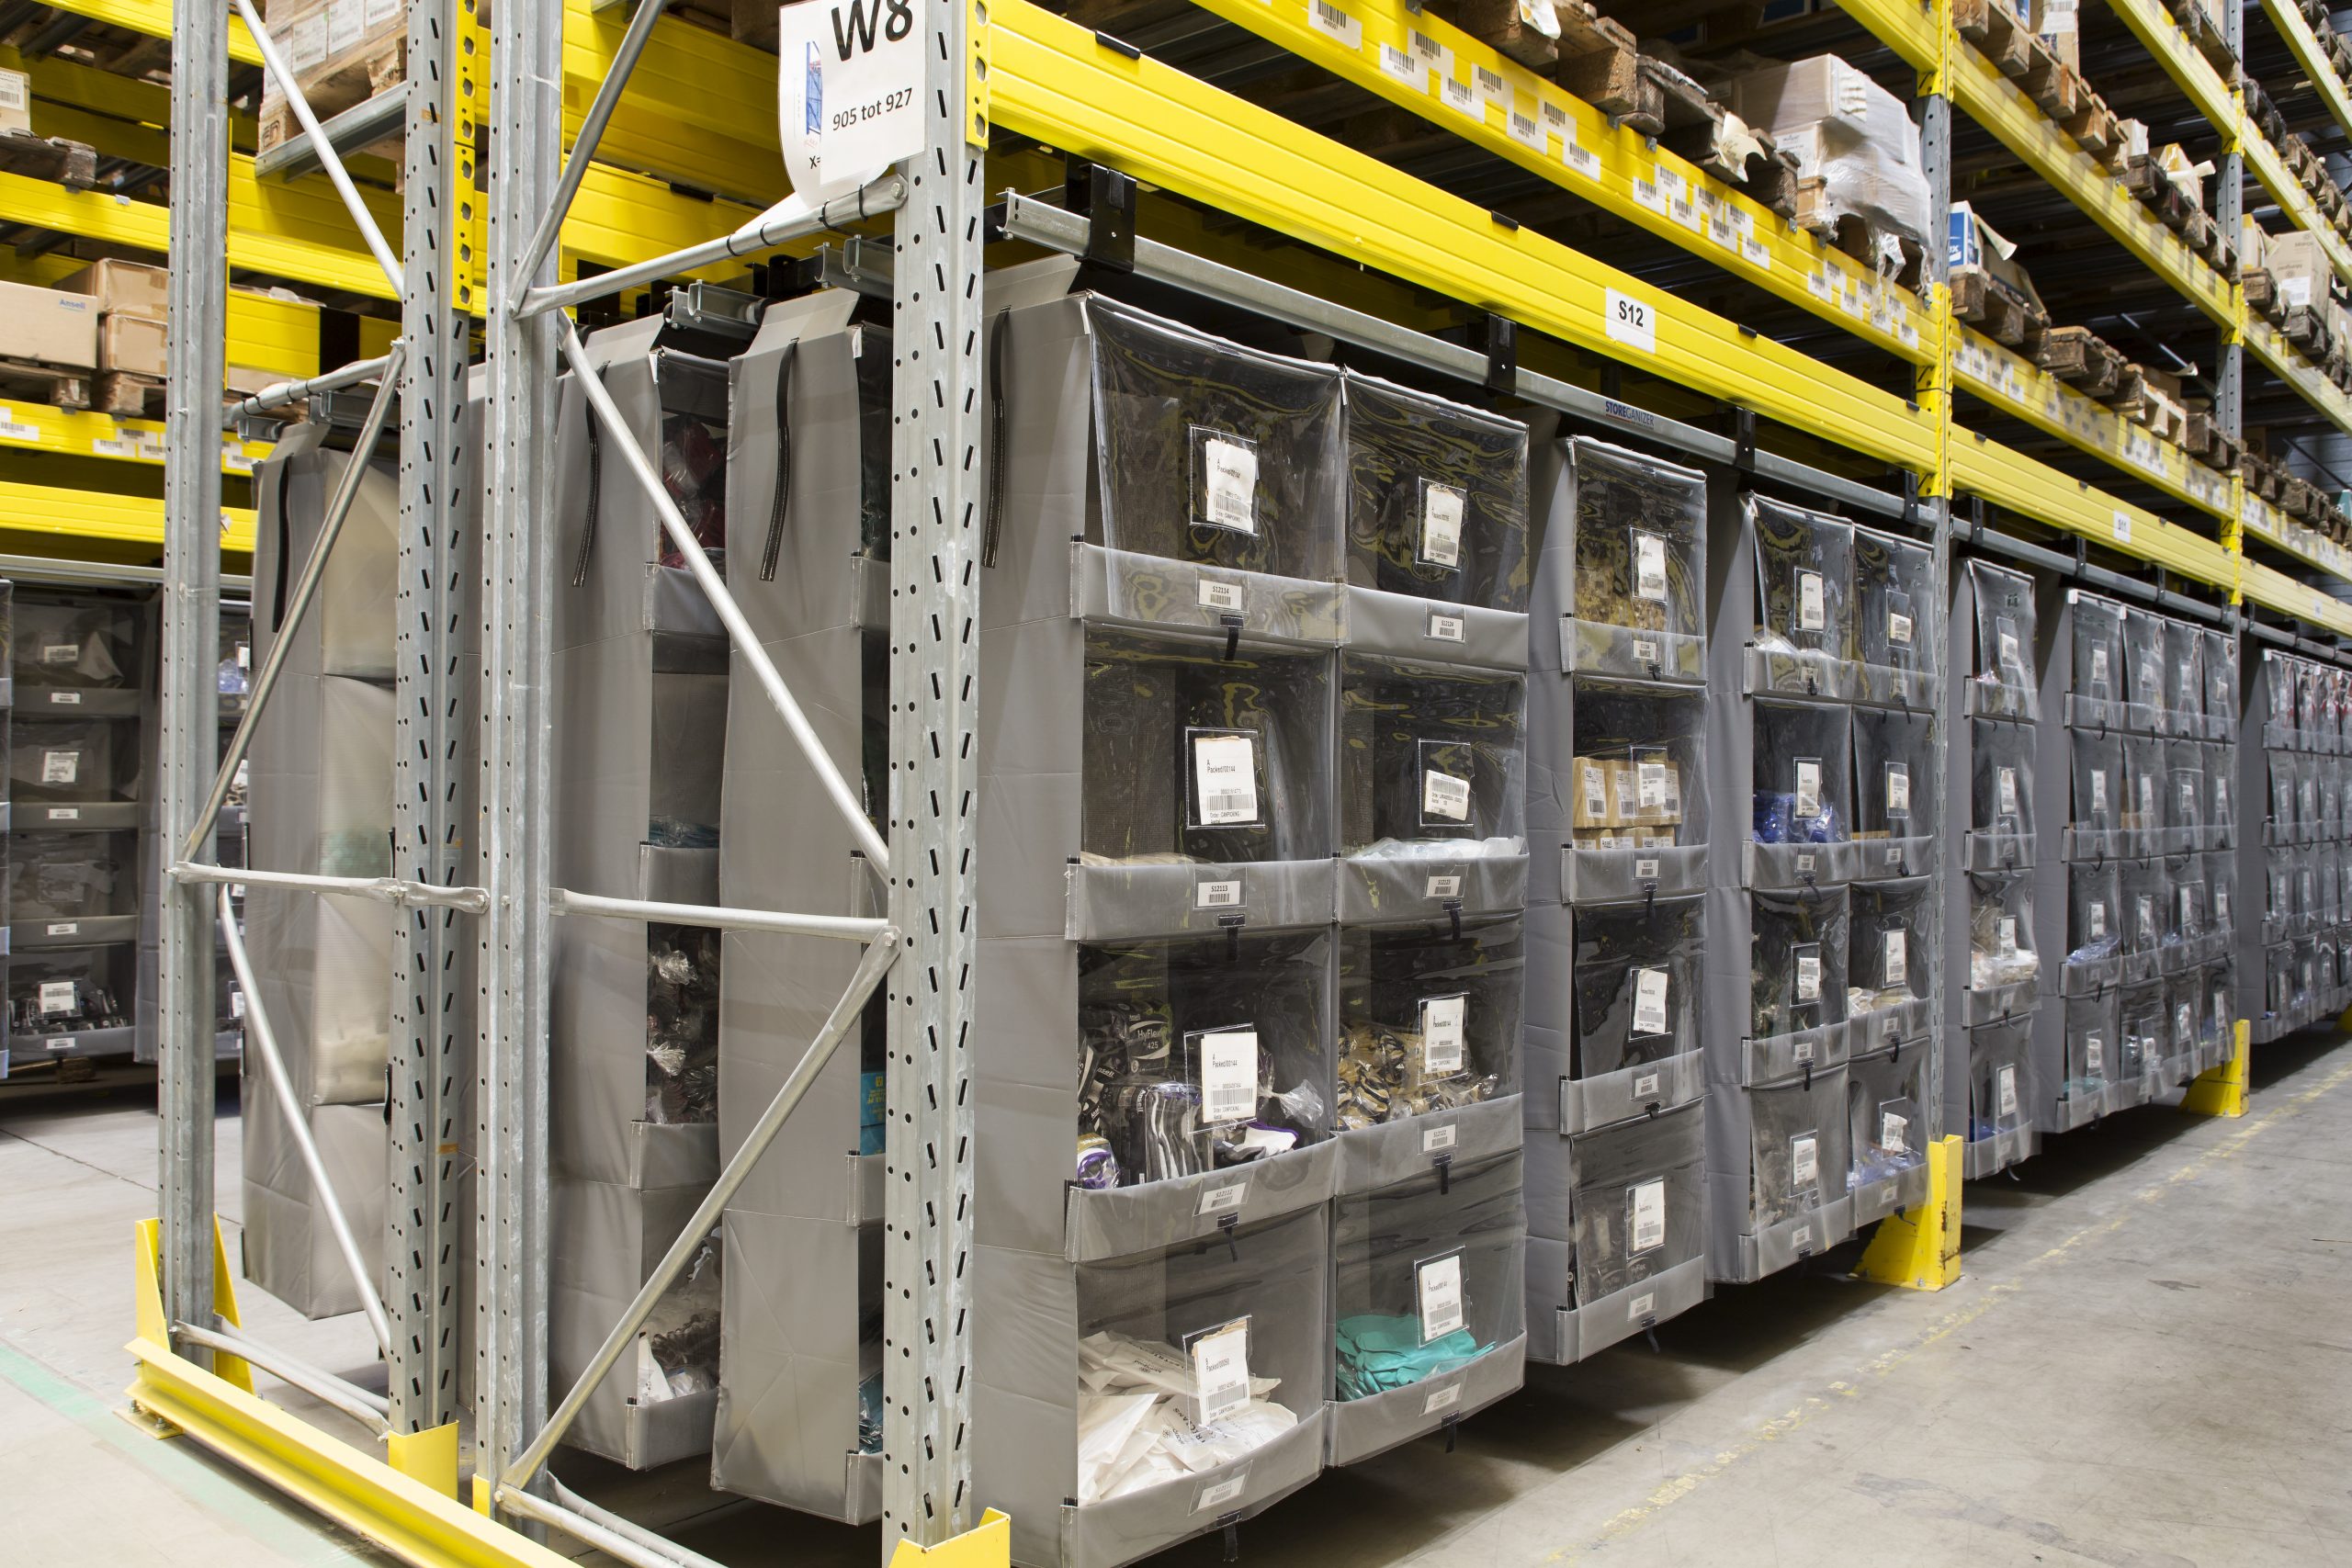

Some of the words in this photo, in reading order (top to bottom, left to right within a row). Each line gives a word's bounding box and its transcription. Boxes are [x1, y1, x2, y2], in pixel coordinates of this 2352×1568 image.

[831, 0, 913, 62] W8
[832, 108, 857, 131] 905
[861, 100, 882, 121] tot
[886, 87, 912, 113] 927
[59, 299, 86, 310] Ansell
[1619, 299, 1644, 328] S12
[1605, 400, 1655, 427] STOREGANIZER
[1212, 585, 1230, 594] S12114
